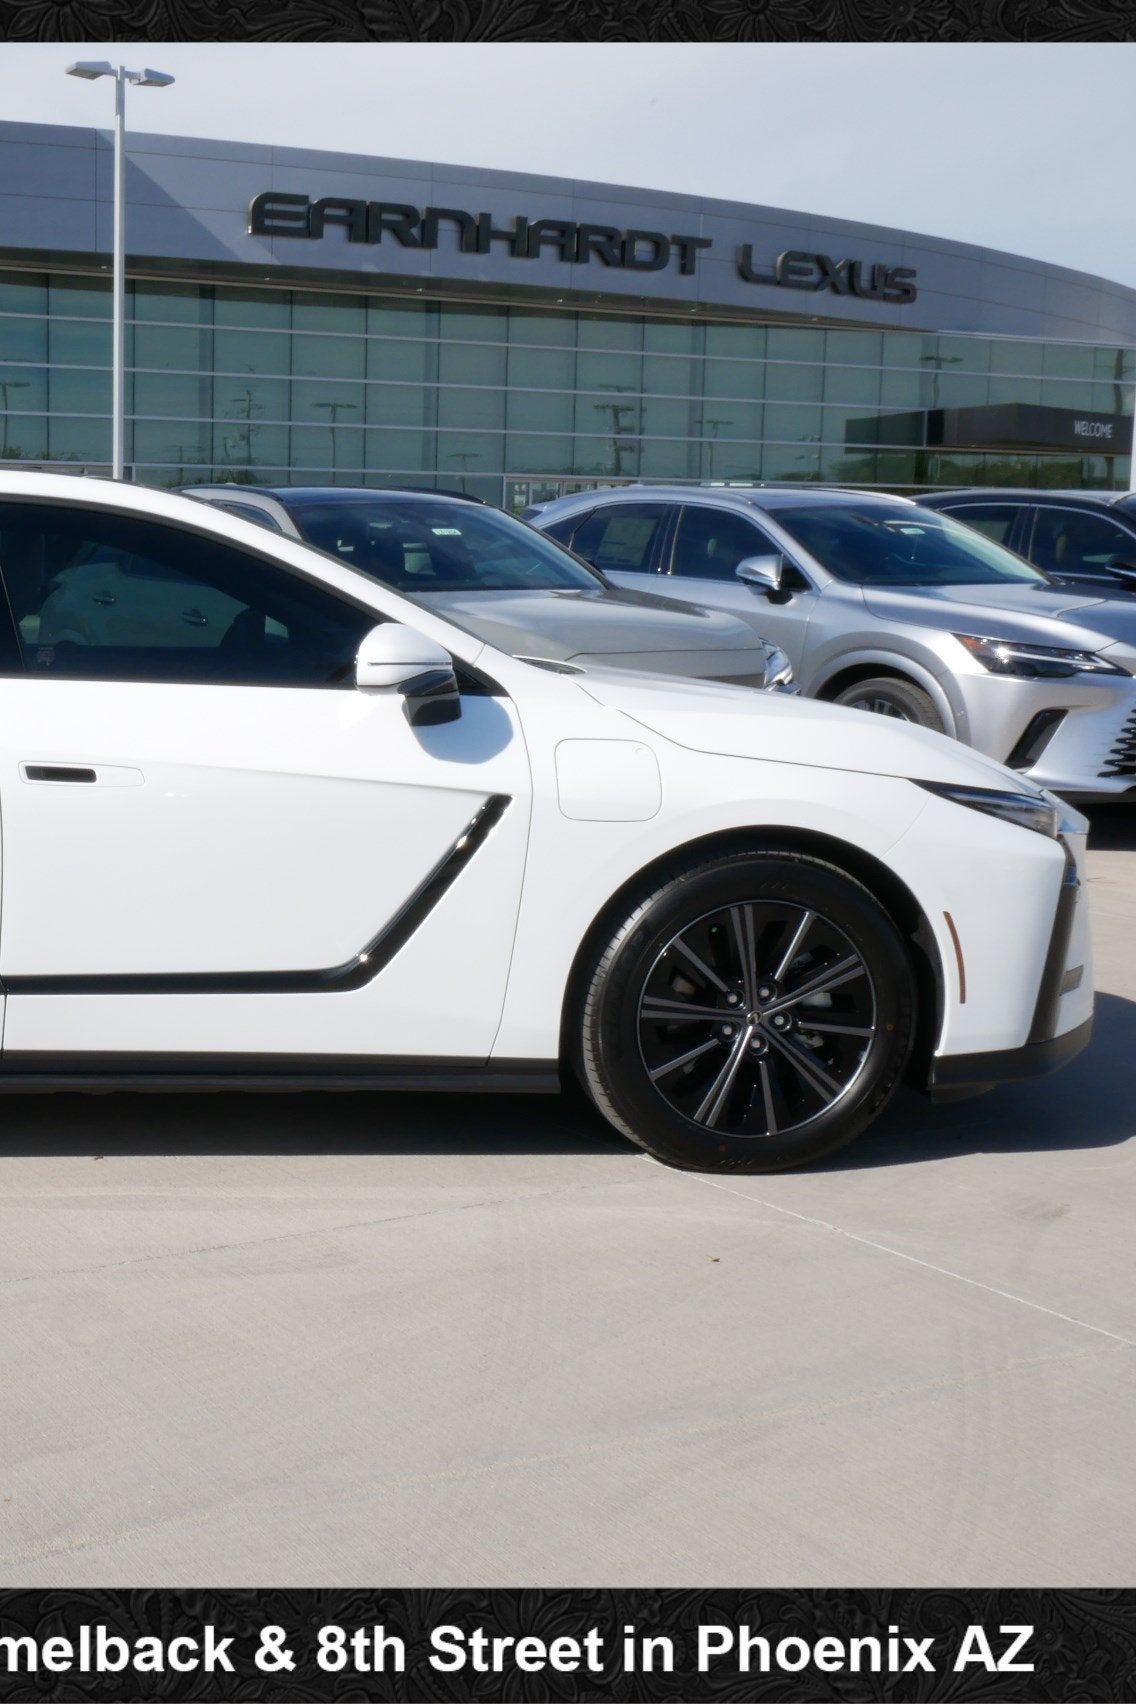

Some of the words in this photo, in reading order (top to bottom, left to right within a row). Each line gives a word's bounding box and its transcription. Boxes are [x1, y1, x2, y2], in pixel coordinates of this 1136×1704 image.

[248, 192, 713, 275] EARNHARDT
[737, 243, 918, 304] LEXUS
[1073, 419, 1113, 439] WELCOME
